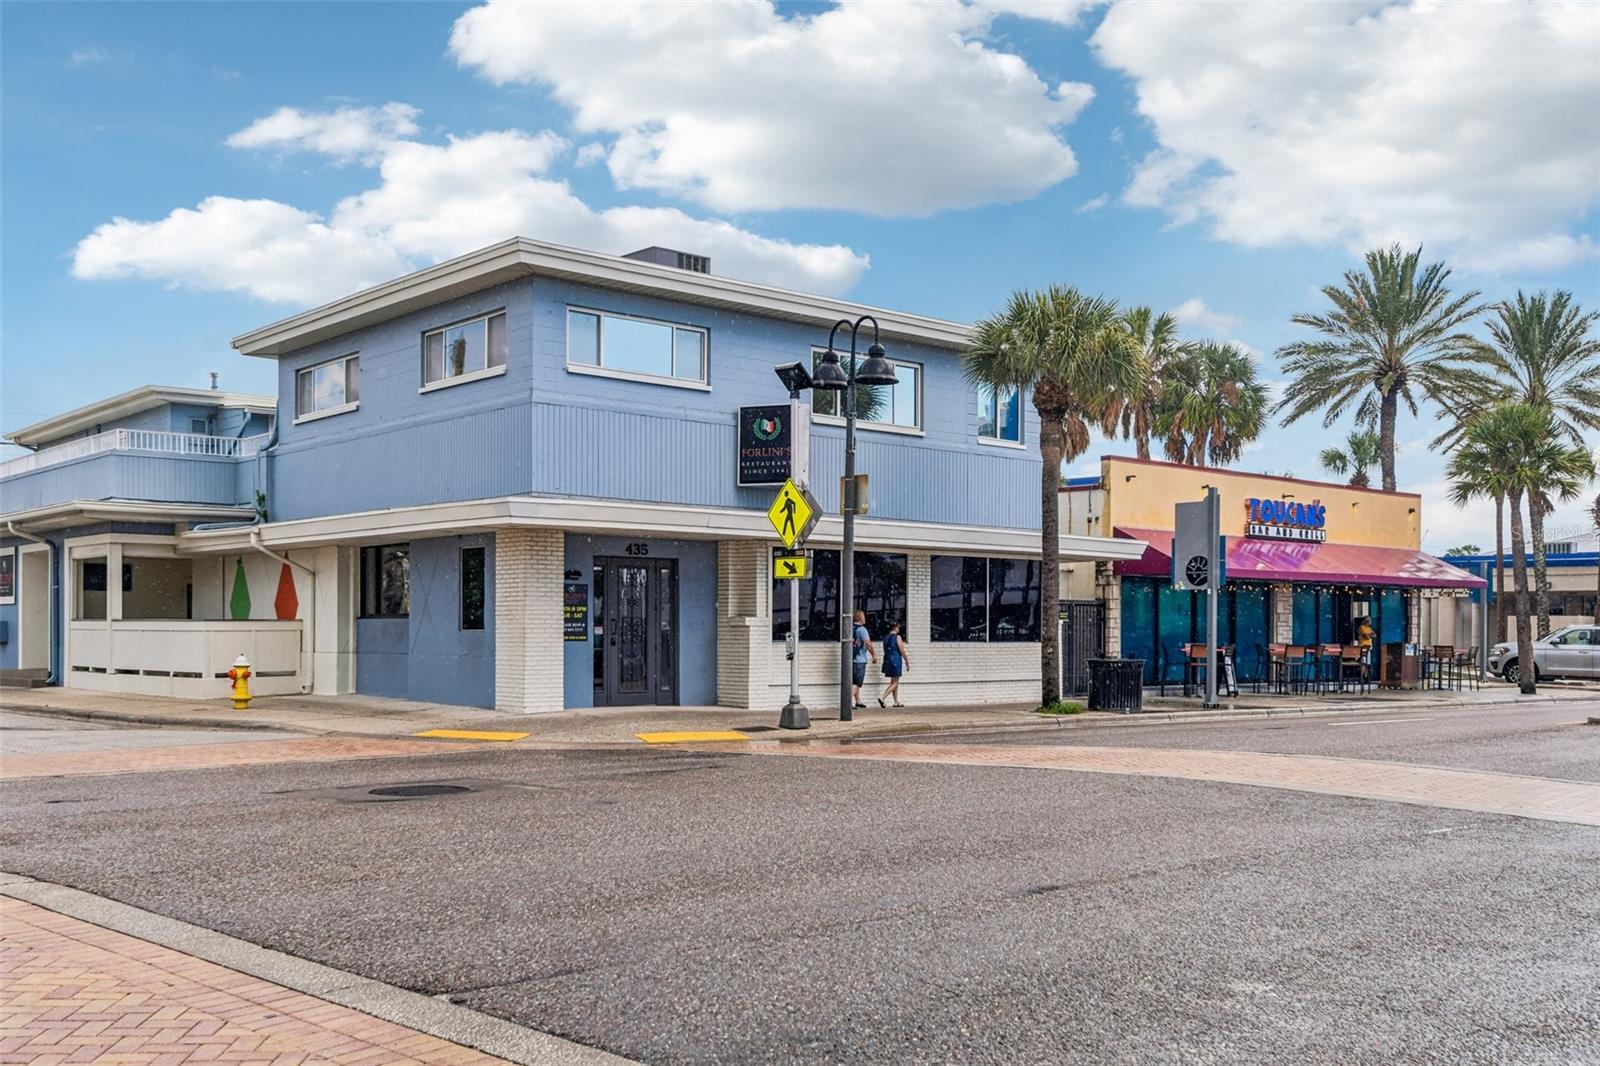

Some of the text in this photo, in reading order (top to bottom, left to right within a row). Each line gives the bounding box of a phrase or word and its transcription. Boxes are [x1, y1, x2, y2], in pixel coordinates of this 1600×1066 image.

[741, 447, 792, 457] FORLINI'S
[1246, 498, 1326, 529] TOUCAN'S
[1251, 525, 1324, 540] BAR AND GRILL
[625, 543, 649, 556] 435
